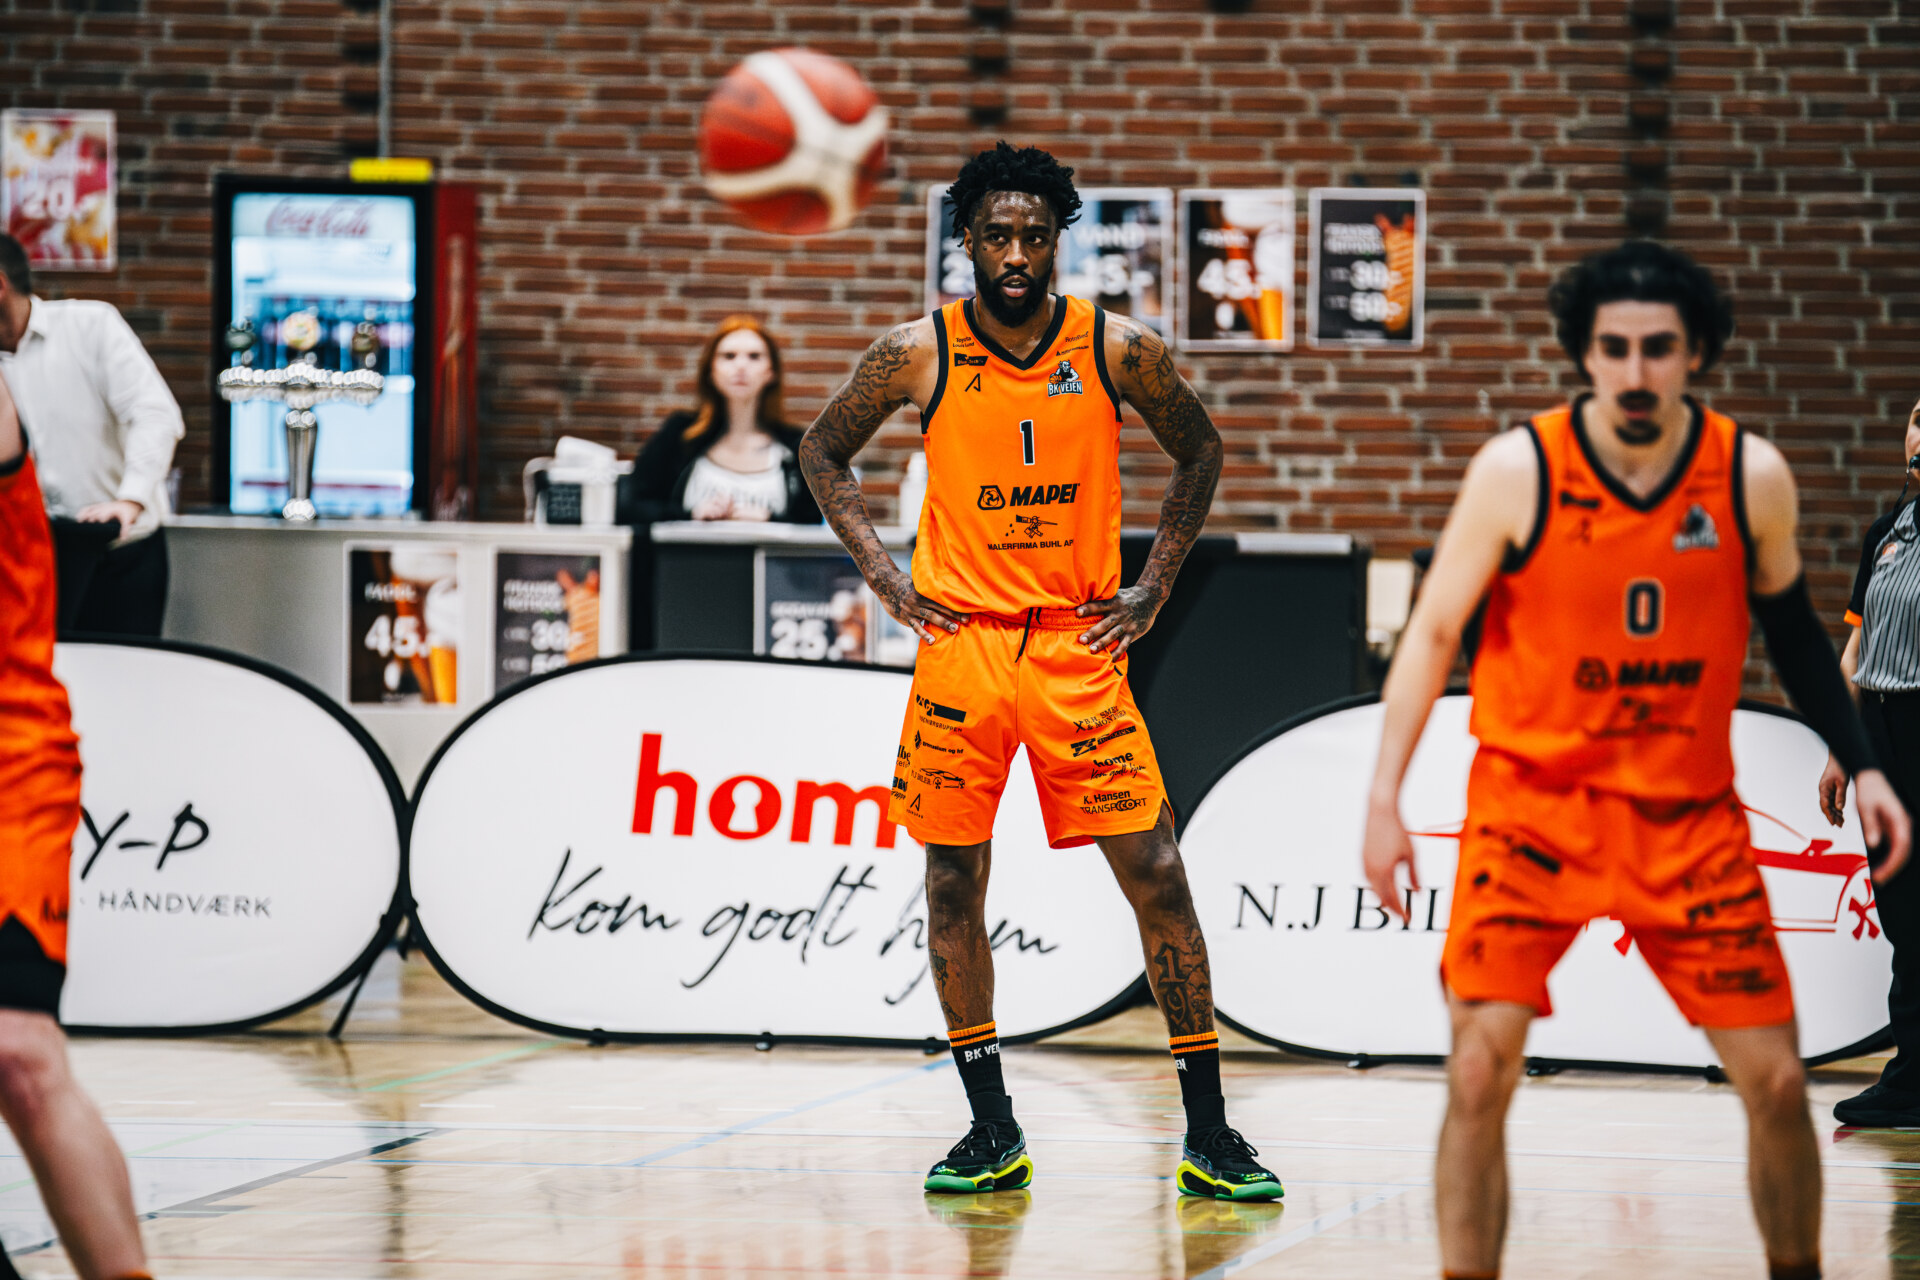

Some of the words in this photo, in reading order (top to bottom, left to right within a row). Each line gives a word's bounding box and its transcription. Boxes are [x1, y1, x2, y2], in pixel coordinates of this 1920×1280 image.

[1048, 382, 1060, 396] BK
[1061, 381, 1083, 395] VEJEN
[1020, 419, 1035, 466] 1
[1009, 483, 1080, 507] MAPEI
[1040, 540, 1062, 549] BUHL
[1624, 576, 1665, 641] 0
[1093, 752, 1134, 768] home
[630, 732, 926, 850] hom
[1083, 795, 1093, 804] K.
[1093, 790, 1131, 804] Hansen
[98, 888, 272, 919] HÅNDVÆRK
[527, 847, 682, 941] Kom
[680, 864, 877, 989] godt
[964, 1047, 983, 1063] BK
